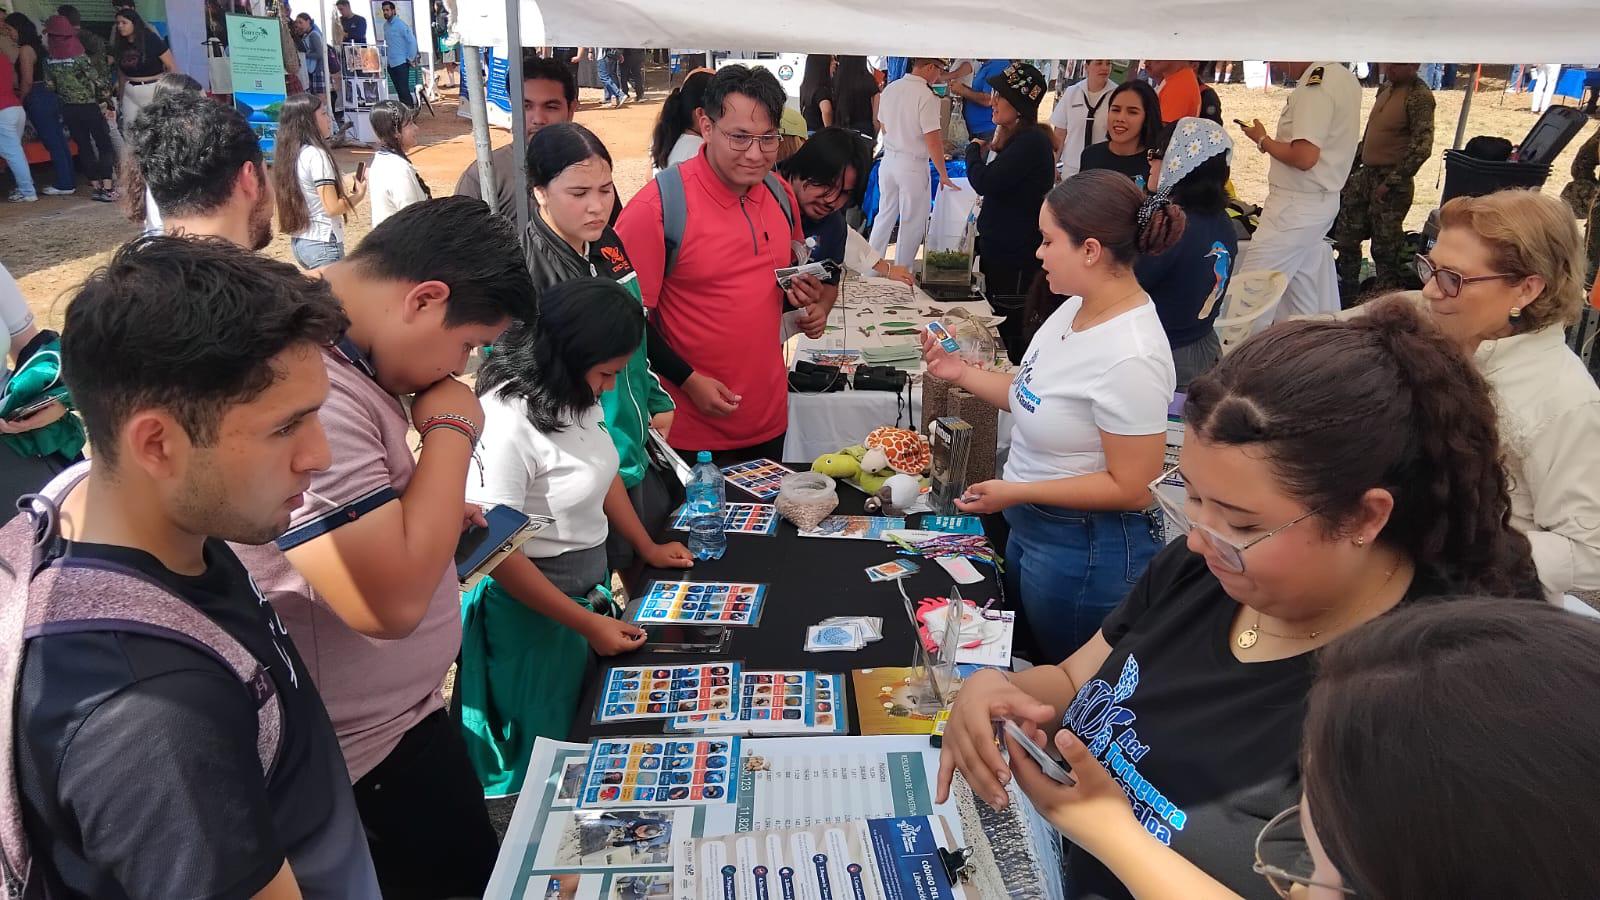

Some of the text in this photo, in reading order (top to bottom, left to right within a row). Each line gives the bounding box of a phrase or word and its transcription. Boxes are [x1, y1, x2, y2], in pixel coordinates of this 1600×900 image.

[1116, 727, 1150, 763] Red
[1105, 740, 1187, 831] Tortuguera
[921, 860, 940, 900] CÓDIGO DEL
